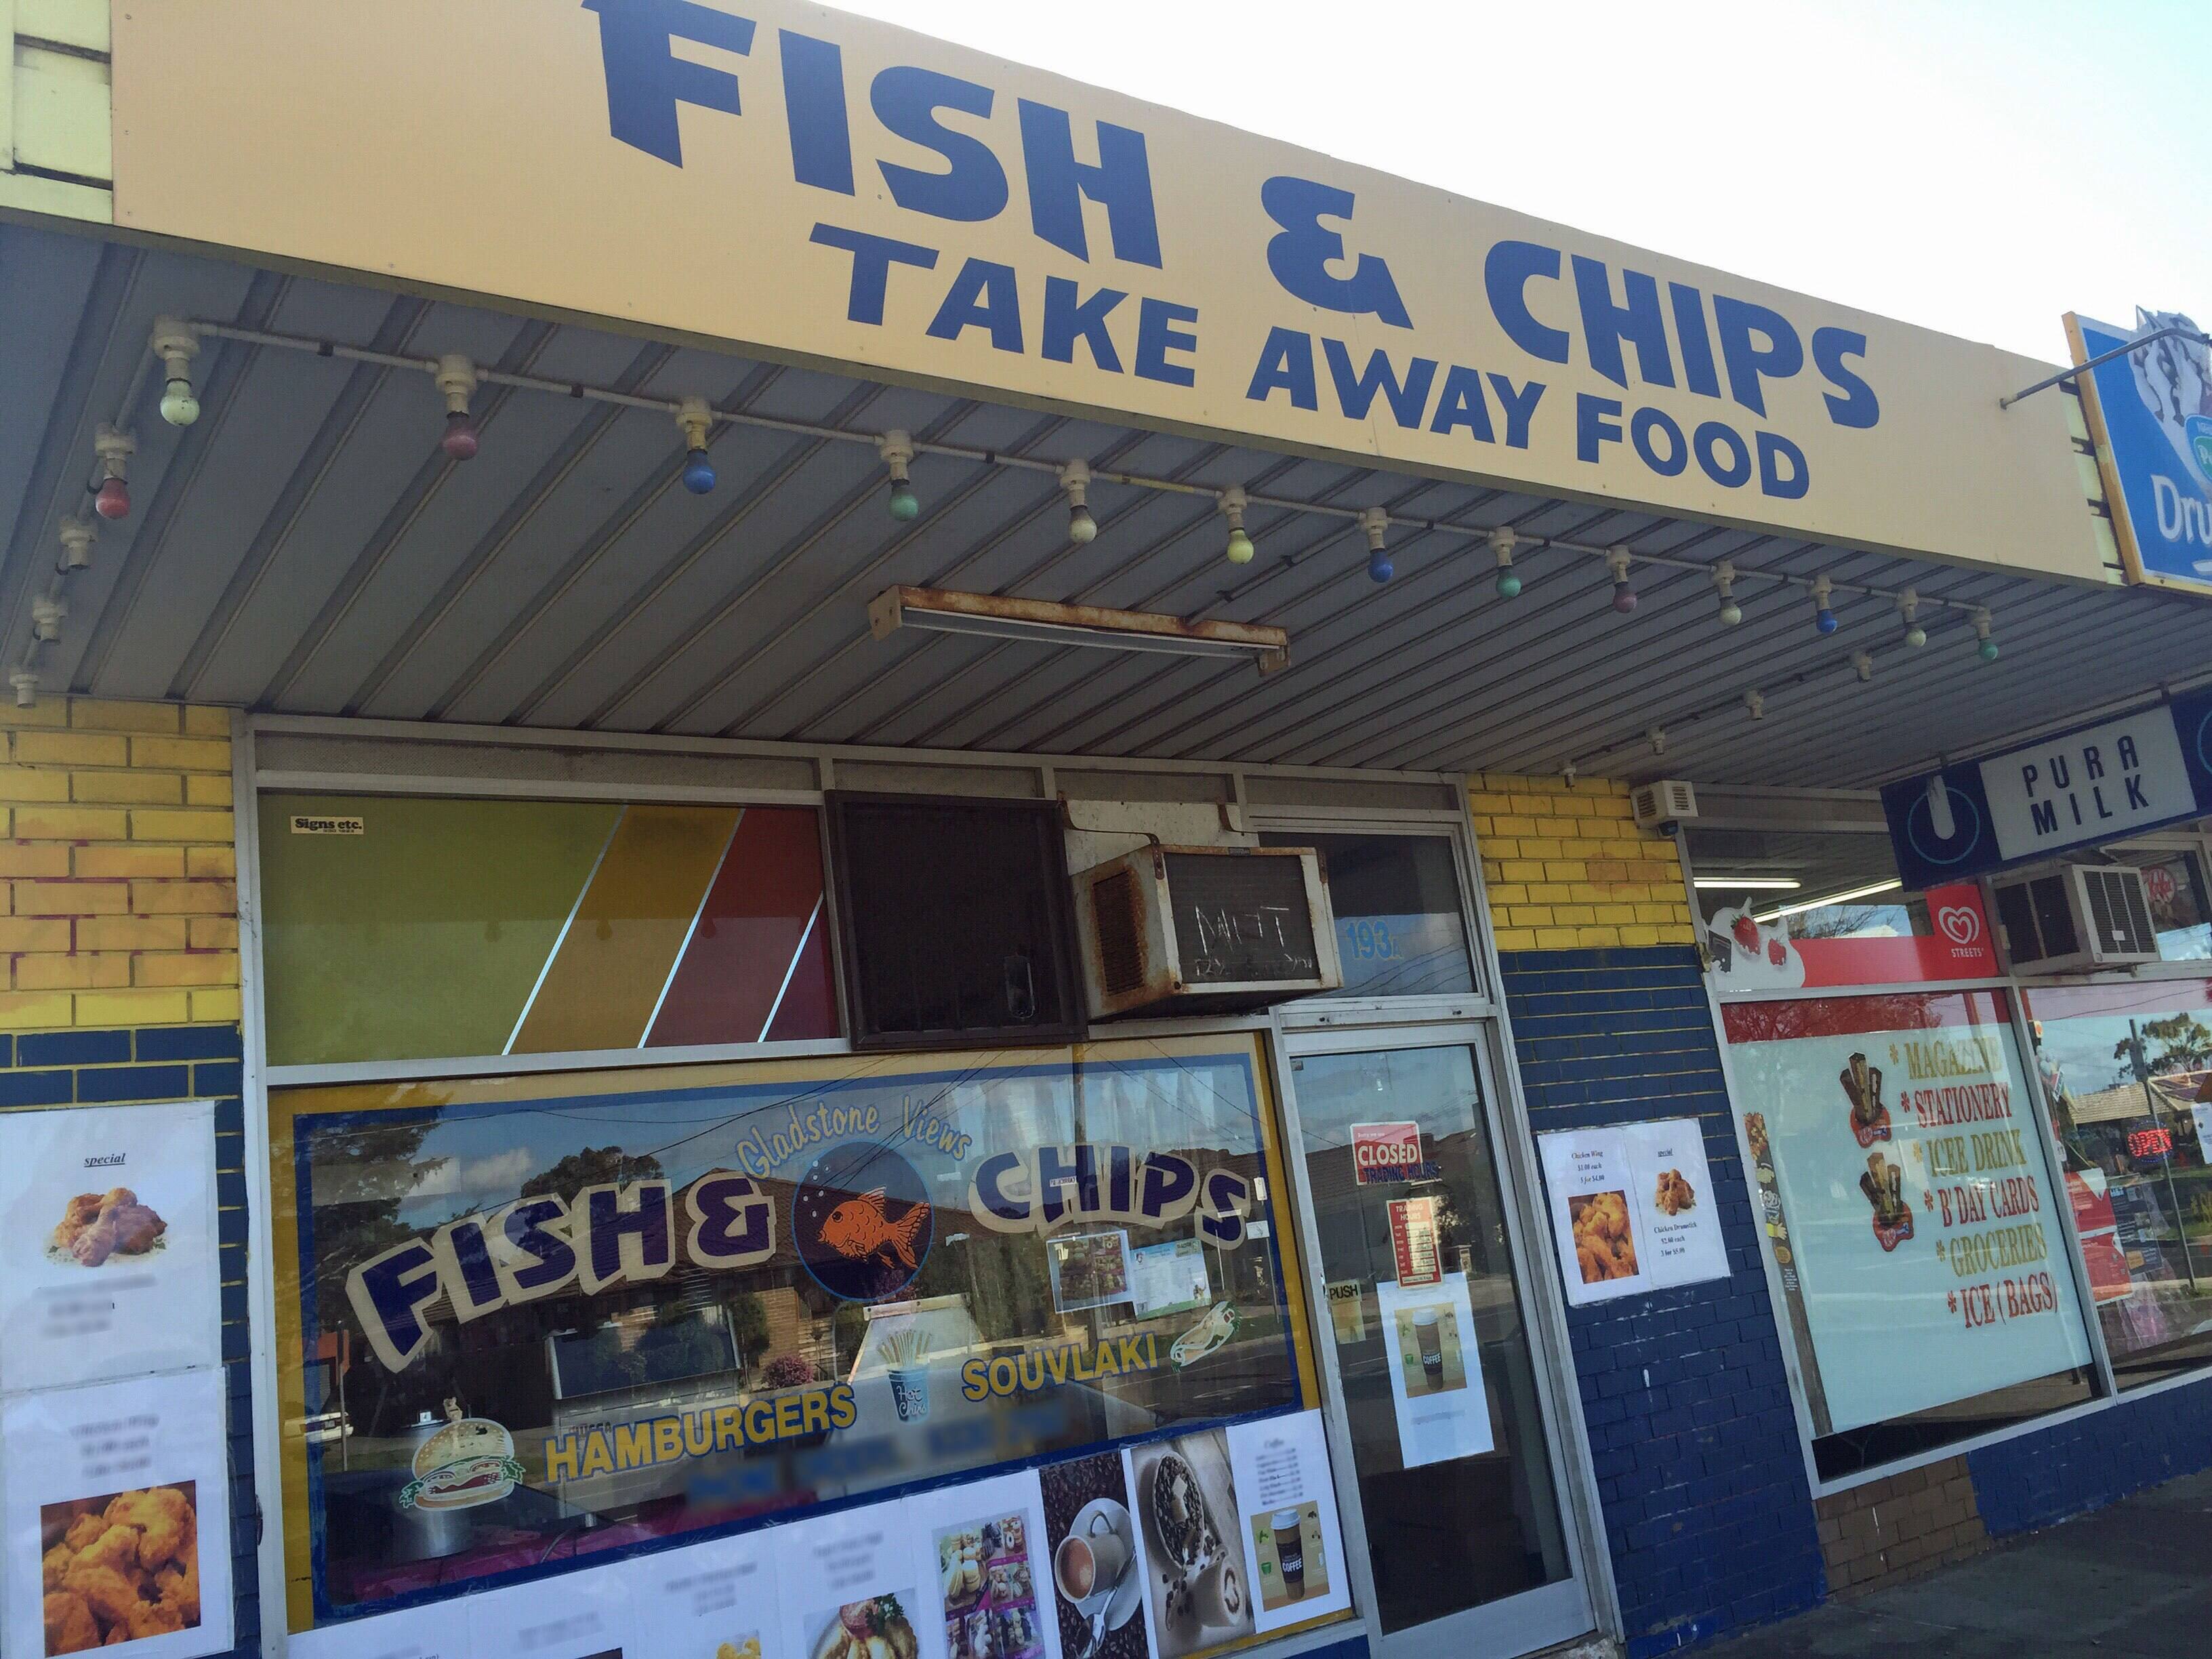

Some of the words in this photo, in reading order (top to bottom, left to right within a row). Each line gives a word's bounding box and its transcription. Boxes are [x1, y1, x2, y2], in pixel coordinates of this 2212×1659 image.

[581, 0, 1162, 270] FISH
[1261, 175, 1414, 330] &
[1483, 239, 1881, 429] CHIPS
[808, 222, 1199, 388] TAKE
[1245, 326, 1547, 450] AWAY
[1576, 392, 1810, 500] FOOD
[2022, 735, 2139, 798] PURA
[295, 818, 335, 832] Signs
[337, 819, 363, 830] etc.
[2030, 774, 2149, 836] MILK
[1914, 1082, 2012, 1128] STATIONERY
[84, 1153, 126, 1168] special
[735, 1101, 880, 1181] Gladstone
[901, 1094, 972, 1161] Views
[1357, 1143, 1418, 1166] CLOSED
[1926, 1136, 1969, 1178] ICEE
[1970, 1128, 2027, 1172] DRINK
[2127, 1128, 2173, 1158] OPEN
[1990, 1175, 2040, 1218] CARDS
[345, 1178, 676, 1374] FISH
[686, 1170, 777, 1268] &
[970, 1143, 1252, 1251] CHIPS
[1950, 1222, 2048, 1277] GROCERIES
[1329, 1284, 1359, 1300] PUSH
[1960, 1284, 1996, 1329] ICE
[961, 1330, 1162, 1403] SOUVLAKI
[1422, 1353, 1442, 1366] COFFEE
[896, 1385, 924, 1402] Hot
[544, 1380, 857, 1488] HAMBURGERS
[1282, 1557, 1302, 1572] COFFEE
